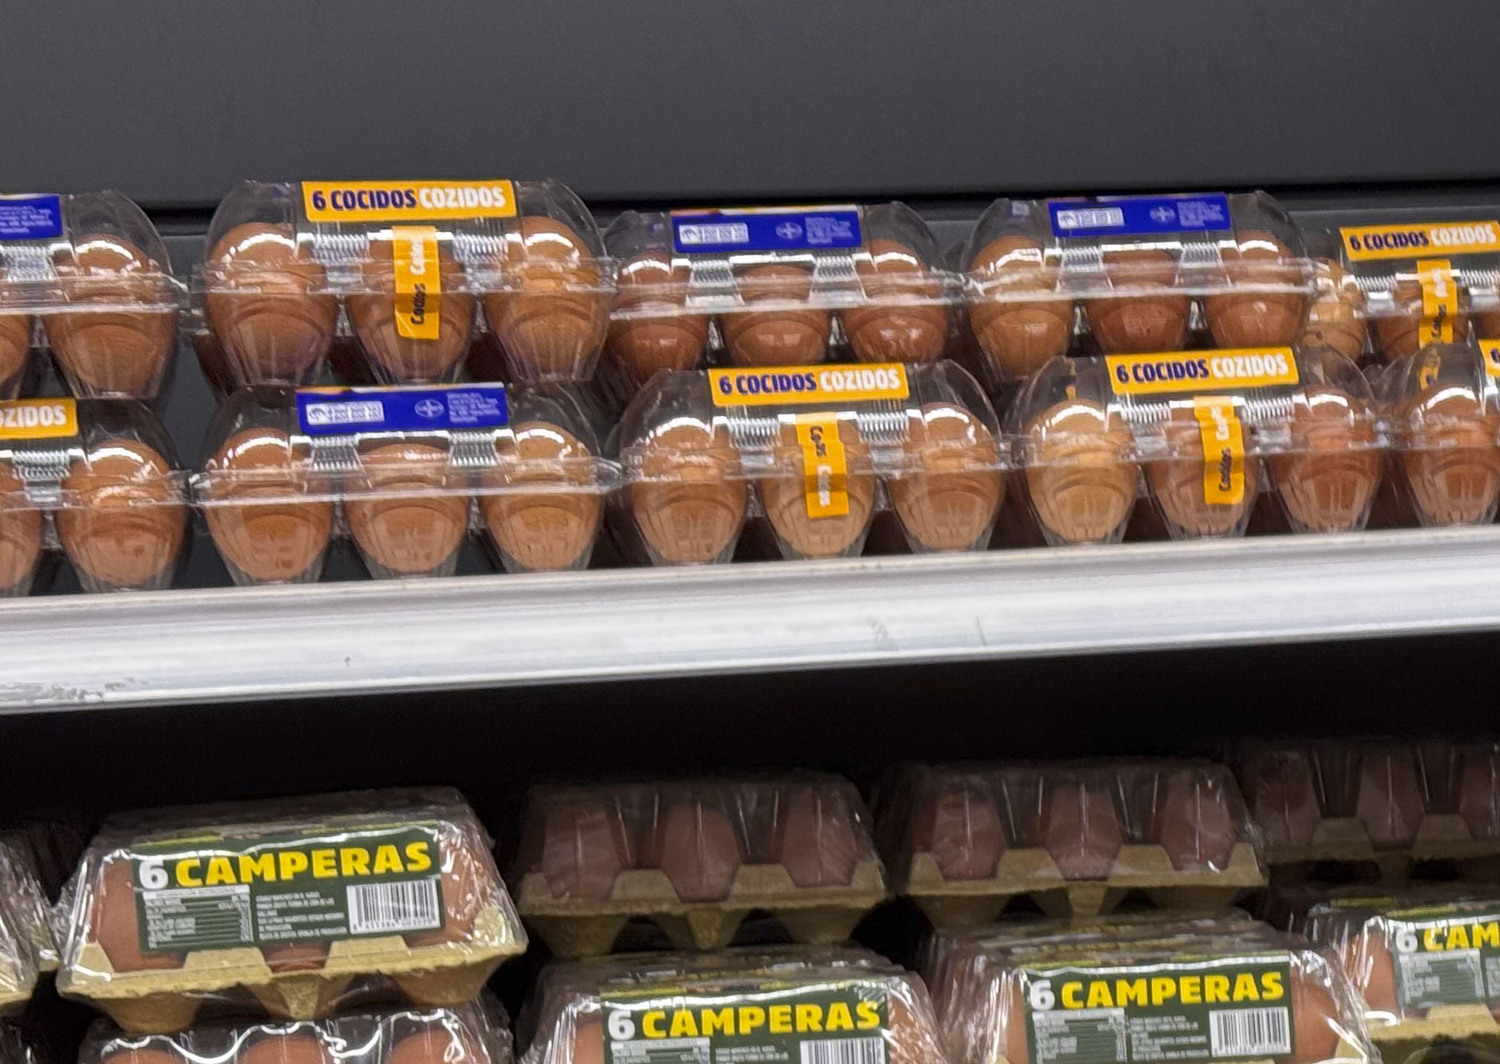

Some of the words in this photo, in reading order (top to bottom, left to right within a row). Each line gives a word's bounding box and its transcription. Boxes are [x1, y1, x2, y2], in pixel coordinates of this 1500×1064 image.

[313, 190, 326, 210] 6
[331, 189, 416, 211] COCIDOS
[419, 187, 506, 209] COZIDOS
[1350, 235, 1361, 252] 6
[1364, 230, 1429, 250] COCIDOS
[1430, 224, 1497, 247] COZIDOS
[719, 376, 733, 395] 6
[736, 373, 817, 395] COCIDOS
[819, 368, 901, 392] COZIDOS
[1116, 364, 1129, 384] 6
[1132, 359, 1209, 382] COCIDOS
[1211, 354, 1289, 379] COZIDOS
[0, 405, 67, 428] ZIDOS
[138, 858, 168, 889] 6
[175, 840, 432, 888] CAMPERAS
[1395, 926, 1418, 953] 6
[1029, 980, 1056, 1010] 6
[1060, 971, 1284, 1010] CAMPERAS
[607, 1009, 635, 1041] 6
[642, 1000, 881, 1039] CAMPERAS
